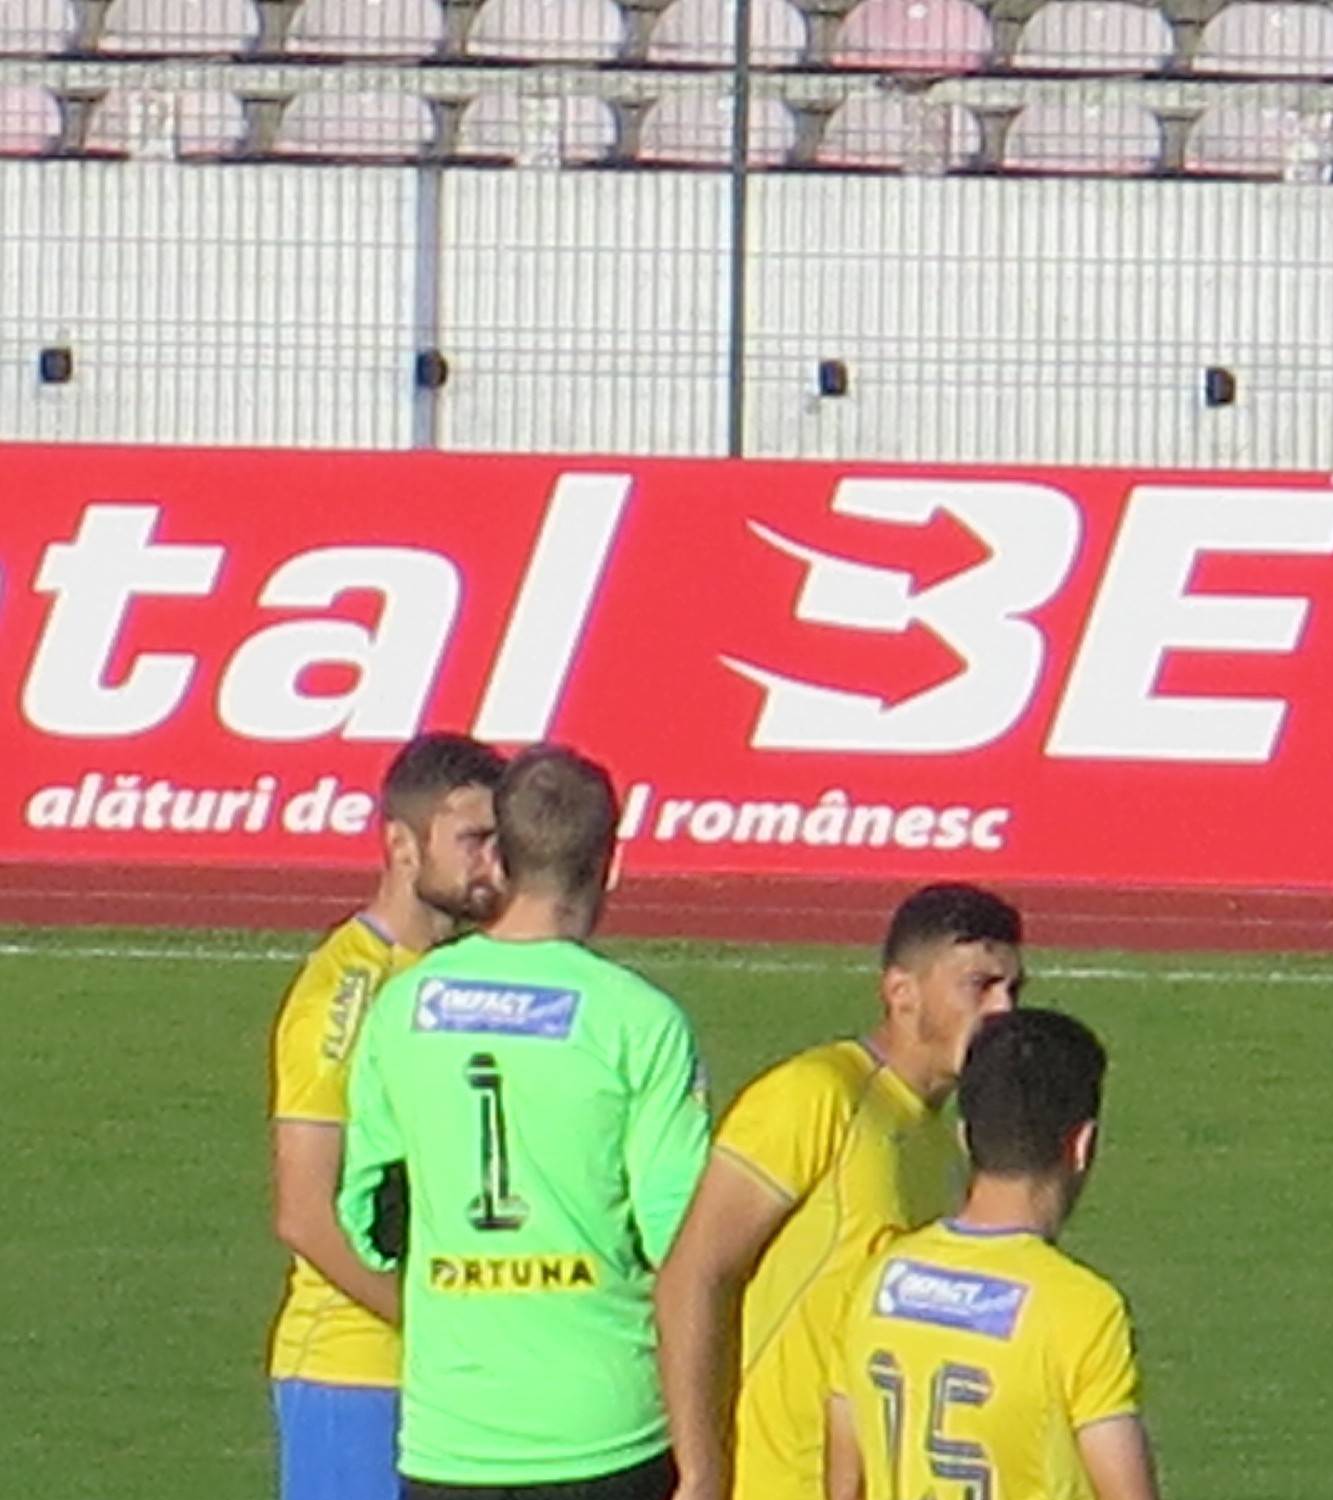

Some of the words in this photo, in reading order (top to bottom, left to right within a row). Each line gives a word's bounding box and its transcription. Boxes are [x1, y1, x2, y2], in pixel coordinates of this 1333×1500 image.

[0, 472, 632, 743] tal
[26, 773, 275, 833] alături
[282, 777, 374, 834] de
[653, 788, 1011, 851] românesc
[465, 1053, 530, 1231] 1
[430, 1255, 595, 1288] FORTUNA
